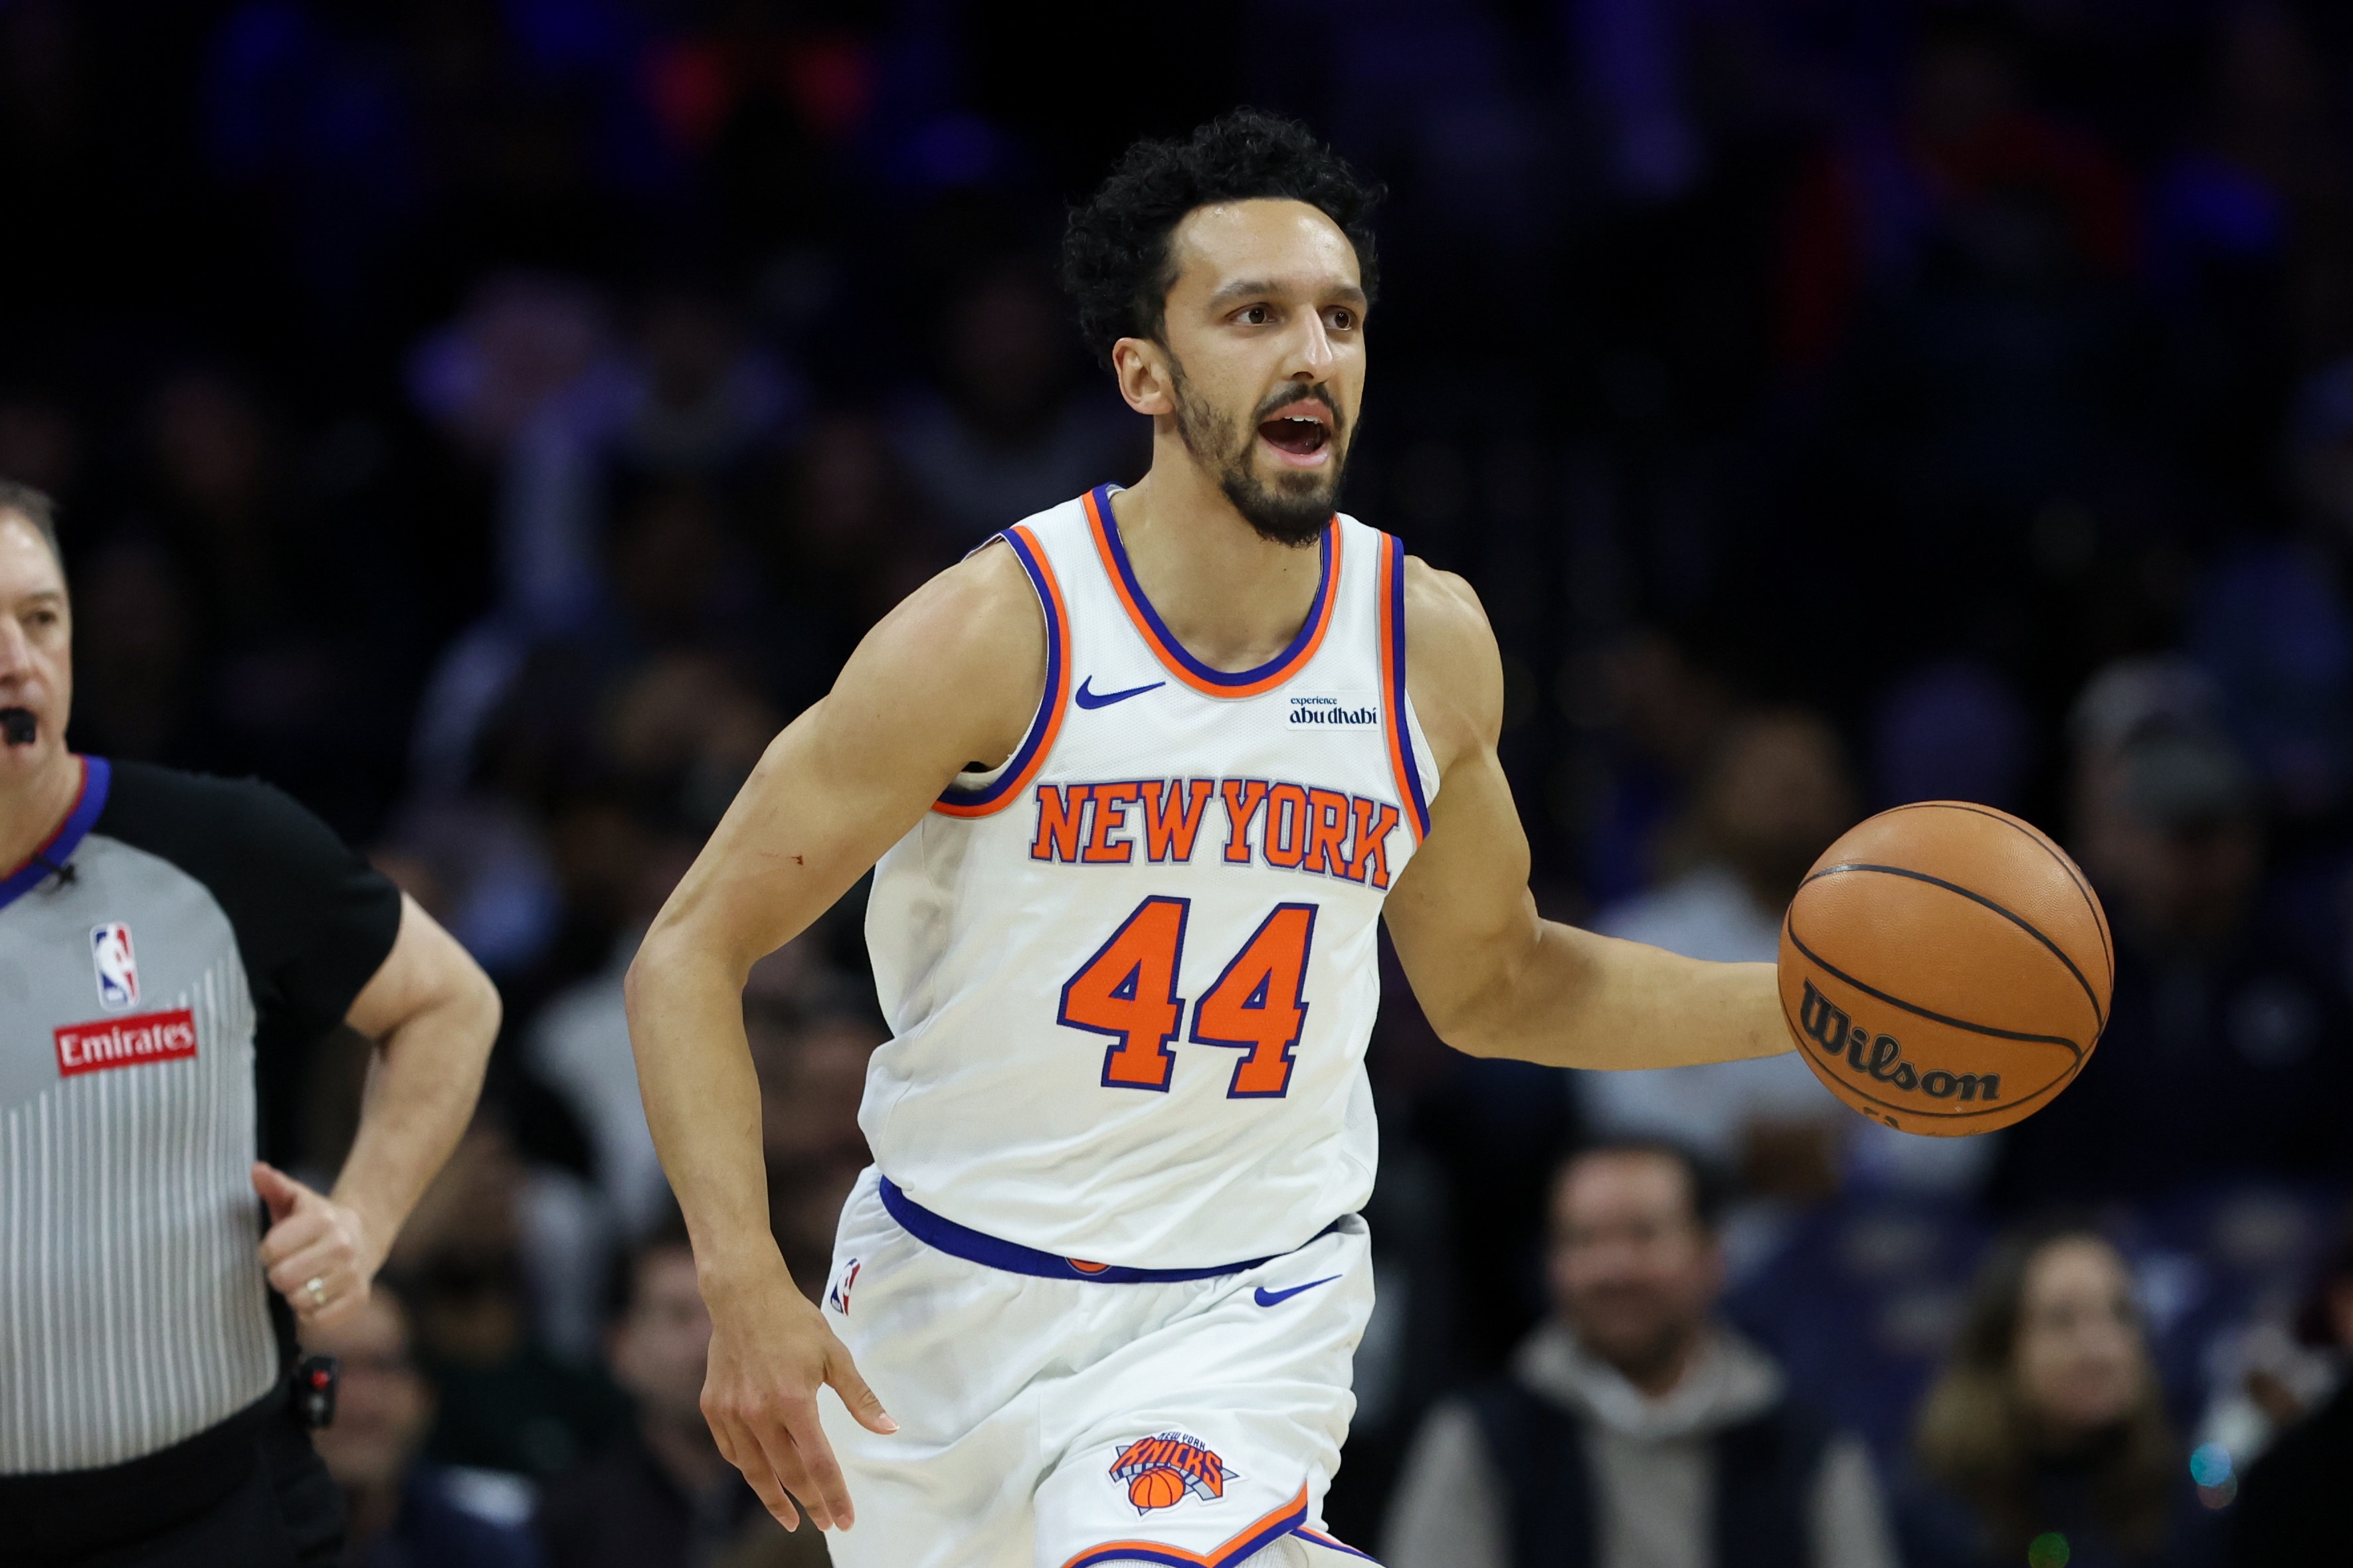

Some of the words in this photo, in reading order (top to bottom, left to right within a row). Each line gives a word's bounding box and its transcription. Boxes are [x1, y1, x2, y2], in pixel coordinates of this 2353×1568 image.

[1289, 706, 1325, 723] abu
[1327, 707, 1377, 724] dhabi
[1290, 696, 1337, 706] experience
[1030, 778, 1214, 864] NEW
[1220, 777, 1400, 891] YORK
[1056, 895, 1319, 1098] 44
[59, 1022, 195, 1067] Emirates
[1800, 977, 2001, 1101] Wilson
[1157, 1431, 1181, 1440] NEW
[1182, 1433, 1206, 1450] YORK
[1109, 1437, 1223, 1498] KNICKS
